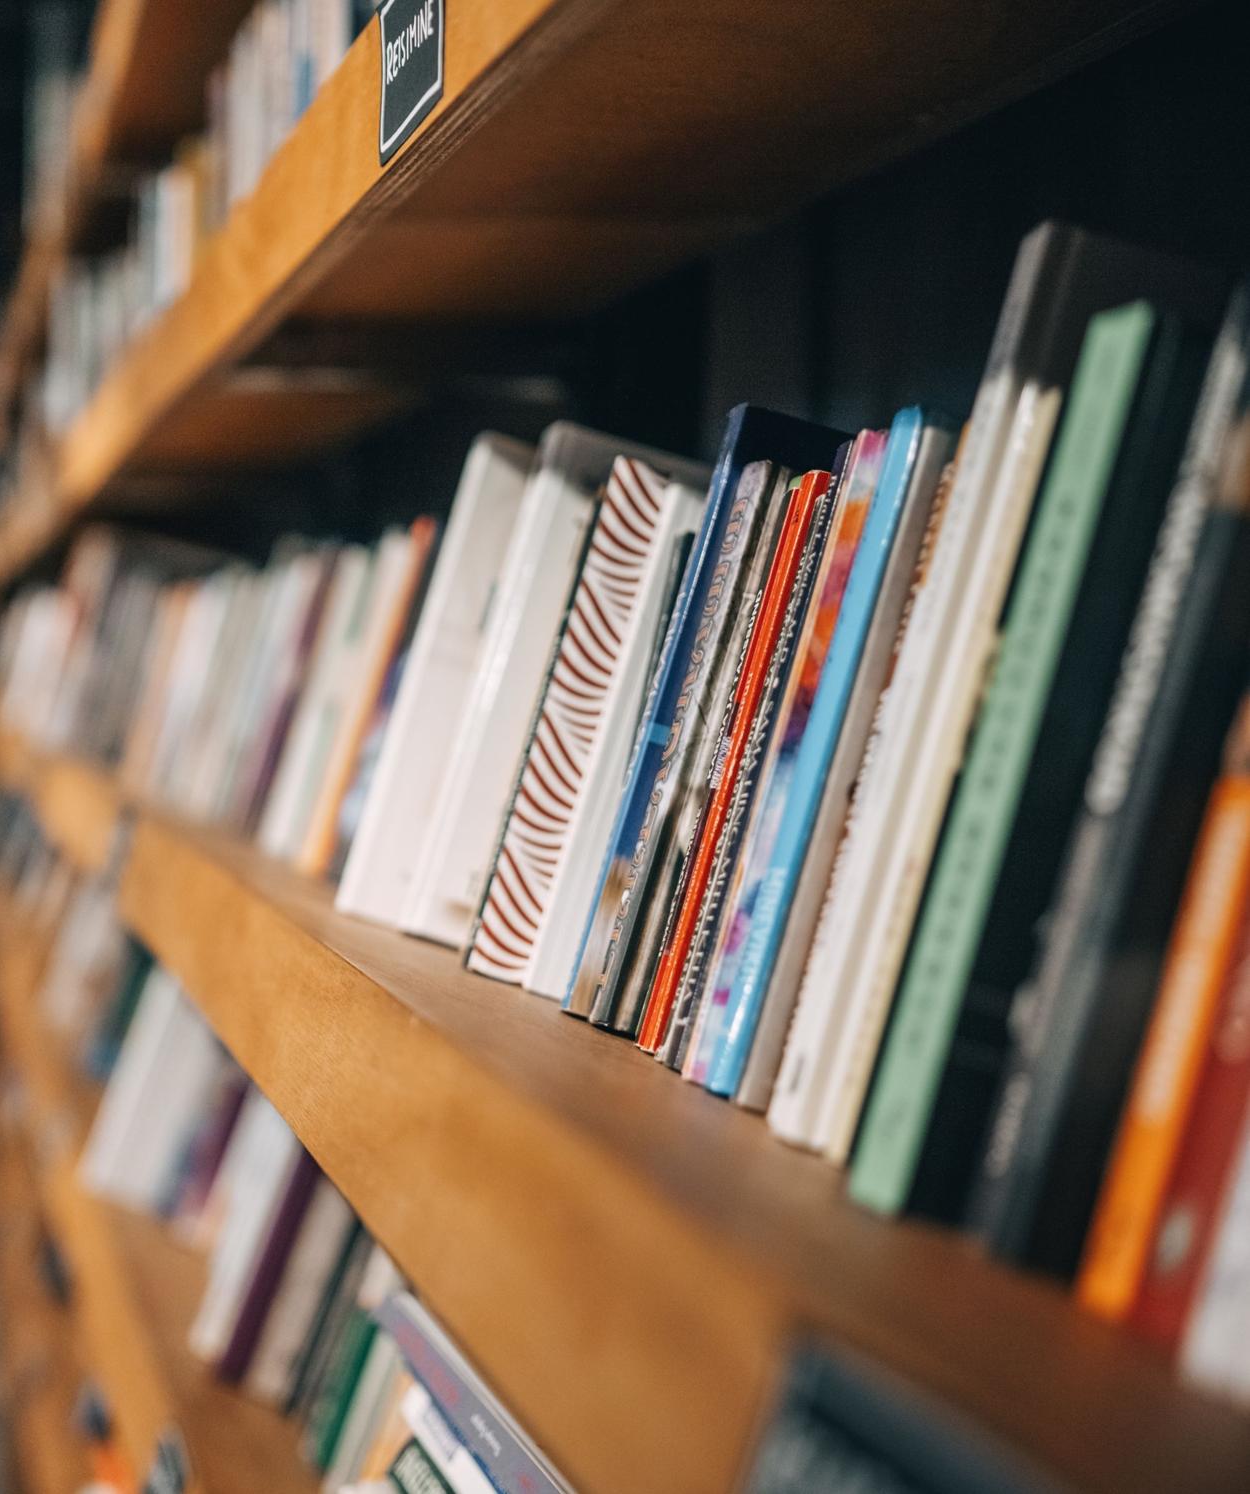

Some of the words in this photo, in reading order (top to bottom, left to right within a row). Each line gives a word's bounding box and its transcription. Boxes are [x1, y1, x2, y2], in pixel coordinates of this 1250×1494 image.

[386, 0, 434, 85] REISIMINE
[658, 899, 677, 958] ILMAR
[673, 806, 702, 896] SOOMERE
[707, 713, 728, 781] KARMA
[726, 689, 736, 710] JA
[732, 589, 763, 685] TAASSÜND
